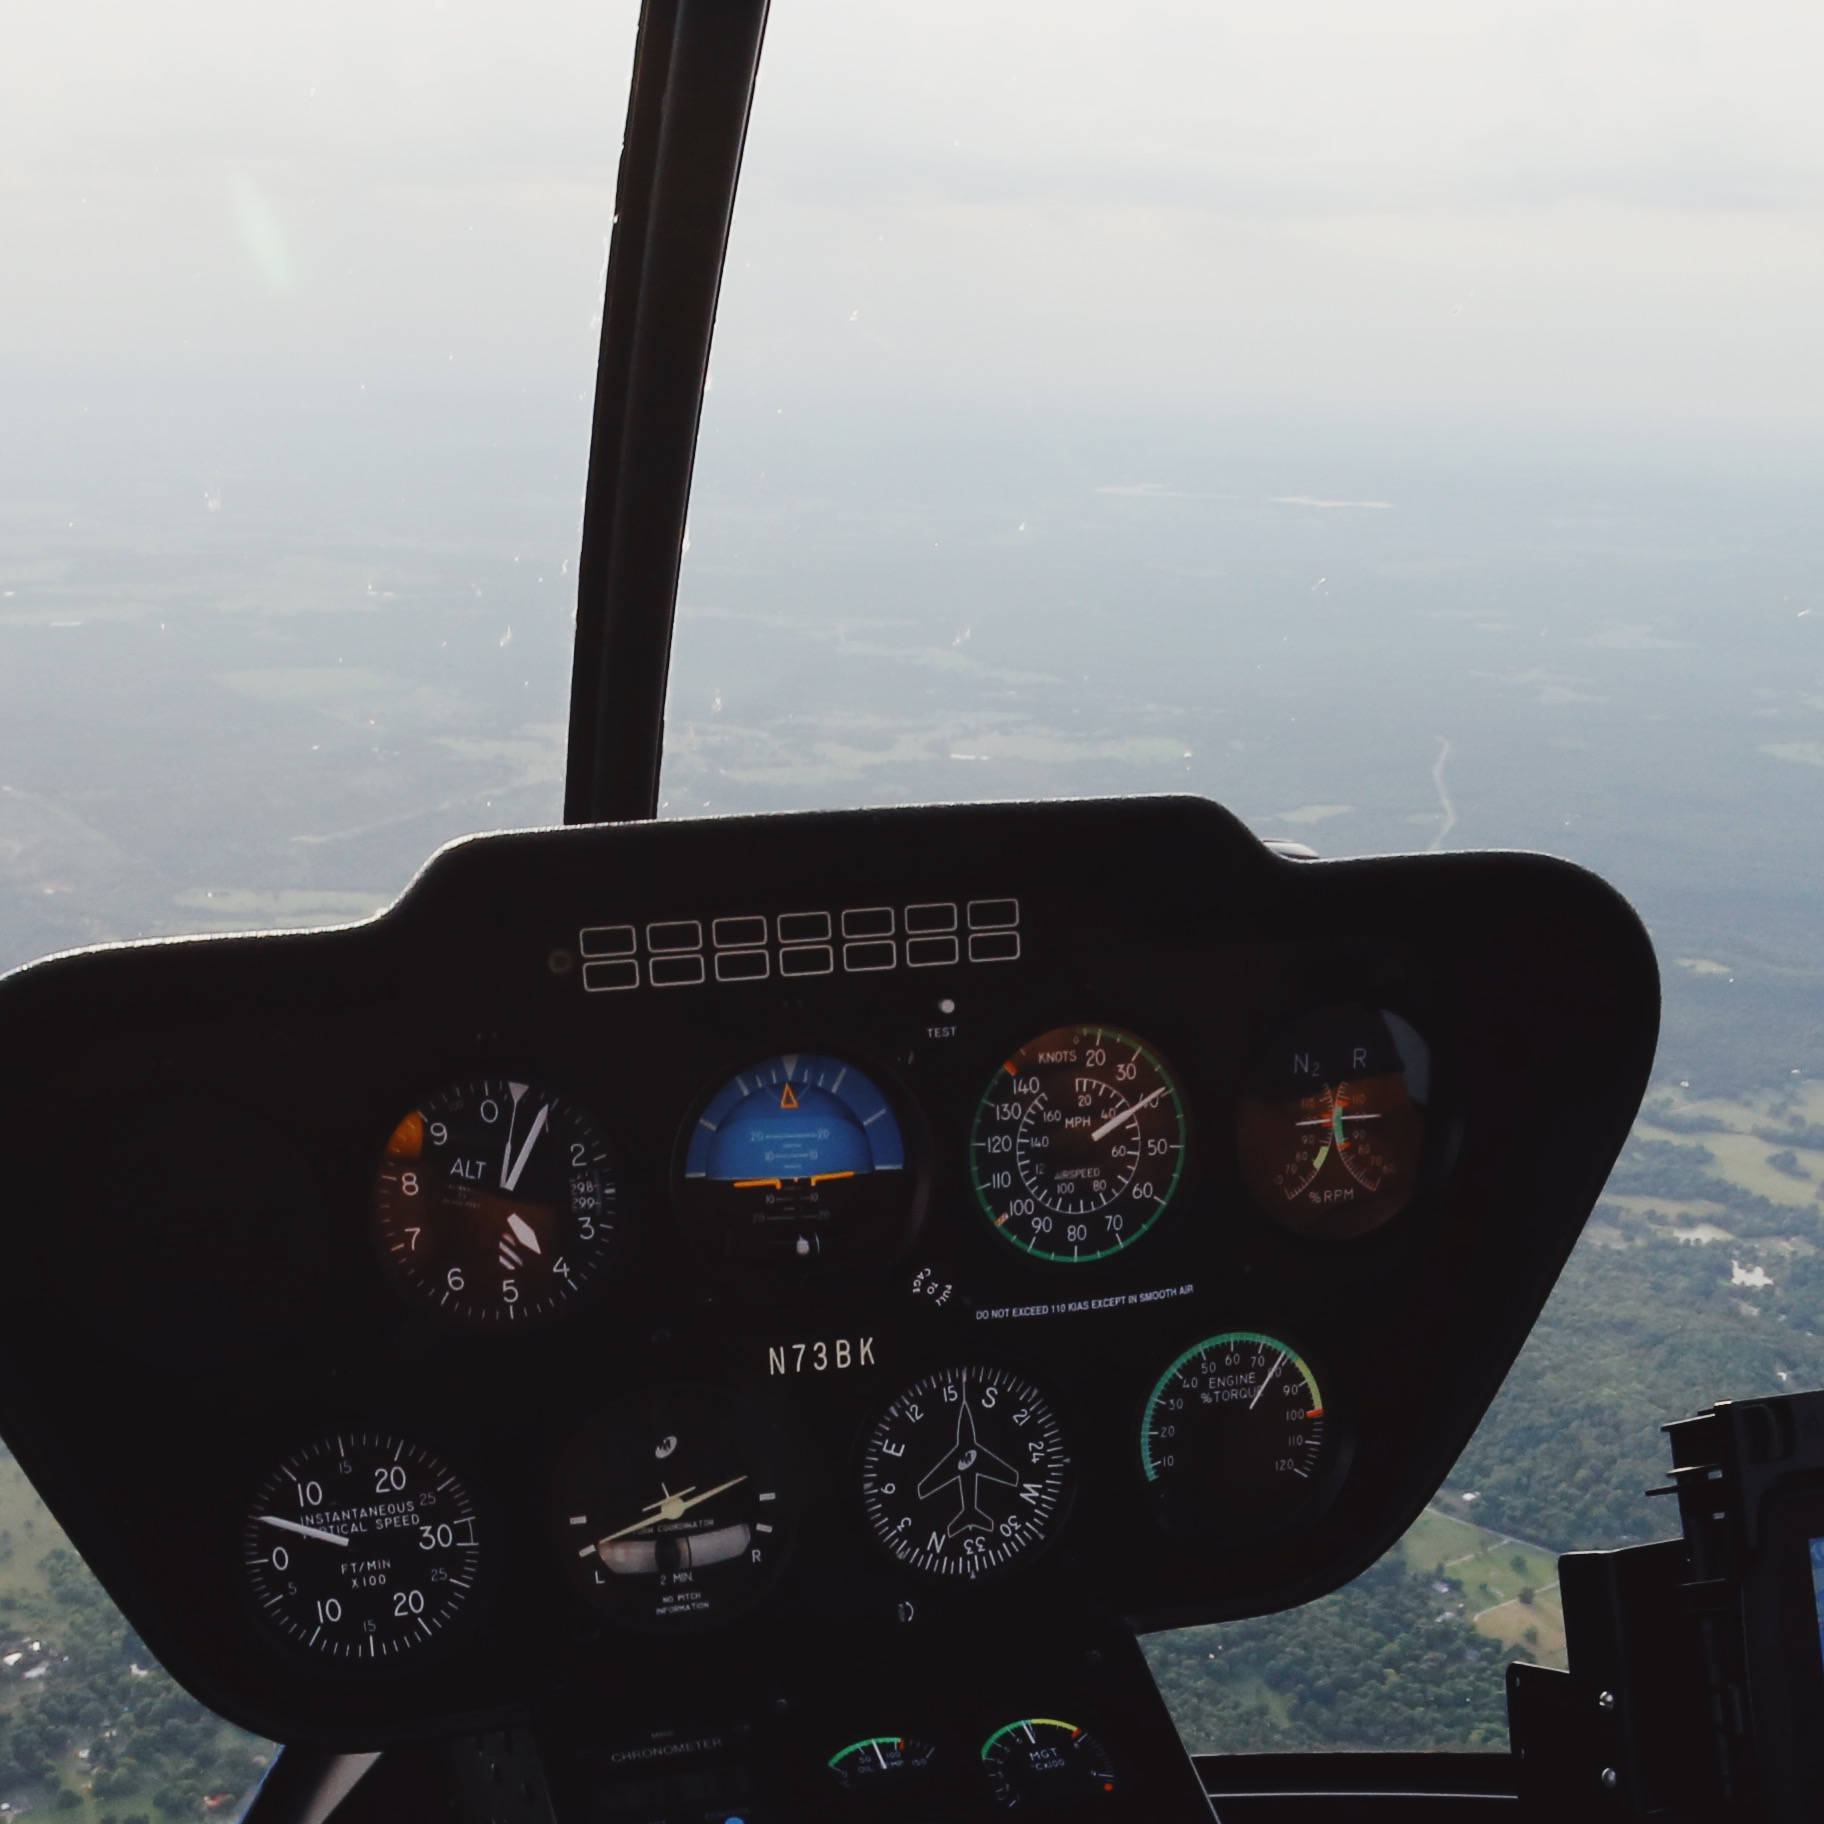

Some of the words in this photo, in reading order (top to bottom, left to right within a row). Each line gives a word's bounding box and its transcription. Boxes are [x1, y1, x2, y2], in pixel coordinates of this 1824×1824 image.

[927, 1026, 957, 1039] TEST
[1038, 1050, 1077, 1064] KNOTS
[1086, 1049, 1106, 1066] 20
[1353, 1048, 1367, 1068] R
[1116, 1064, 1136, 1081] 30
[1013, 1076, 1040, 1094] 140
[480, 1100, 498, 1122] 0
[996, 1104, 1022, 1121] 130
[1043, 1110, 1062, 1122] 160
[1065, 1116, 1091, 1128] MPH
[430, 1123, 447, 1145] 9
[987, 1135, 1012, 1153] 120
[1111, 1146, 1126, 1157] 60
[1148, 1139, 1168, 1155] 50
[571, 1144, 586, 1166] 2
[450, 1158, 487, 1180] ALT
[402, 1173, 419, 1196] 8
[992, 1171, 1011, 1188] 110
[1057, 1182, 1074, 1194] 100
[1093, 1180, 1106, 1192] 80
[1132, 1183, 1153, 1199] 60
[1009, 1199, 1034, 1216] 100
[578, 1217, 594, 1240] 3
[1031, 1217, 1052, 1233] 90
[1105, 1214, 1124, 1231] 70
[404, 1228, 420, 1250] 7
[1067, 1224, 1087, 1241] 80
[553, 1257, 570, 1278] 4
[447, 1268, 464, 1291] 6
[912, 1268, 931, 1294] CAGE
[502, 1280, 518, 1302] 5
[976, 1310, 989, 1320] DO
[991, 1308, 1009, 1319] NOT
[1012, 1305, 1049, 1317] EXCEED
[1051, 1304, 1066, 1314] 110
[1068, 1301, 1089, 1312] KIAS
[1091, 1296, 1126, 1309] EXCEPT
[1128, 1295, 1138, 1304] IN
[1139, 1288, 1177, 1302] SMOOTH
[1179, 1284, 1194, 1295] AIR
[768, 1337, 876, 1375] N73BK
[1225, 1353, 1240, 1366] 60
[1250, 1356, 1265, 1367] 70
[1201, 1362, 1216, 1374] 50
[1182, 1377, 1198, 1388] 40
[1208, 1372, 1256, 1389] ENGINE
[943, 1385, 958, 1402] 15
[982, 1387, 998, 1408] S
[1283, 1385, 1298, 1396] 90
[905, 1404, 924, 1423] 12
[1012, 1408, 1031, 1426] 21
[1285, 1410, 1304, 1421] 100
[1160, 1426, 1175, 1438] 20
[1288, 1435, 1303, 1446] 110
[882, 1439, 905, 1457] E
[1028, 1441, 1044, 1464] 24
[339, 1460, 352, 1474] 15
[1163, 1456, 1174, 1467] 10
[1276, 1460, 1294, 1472] 120
[375, 1466, 406, 1493] 20
[297, 1481, 322, 1507] 10
[300, 1501, 415, 1526] INSTANTANEOUS
[376, 1513, 420, 1530] SPEED
[1000, 1515, 1022, 1537] 30
[419, 1524, 453, 1550] 30
[927, 1531, 946, 1553] N
[964, 1536, 986, 1555] 33
[272, 1547, 288, 1570] 0
[752, 1549, 762, 1563] R
[341, 1559, 391, 1575] FT/MIN
[431, 1568, 447, 1581] 25
[351, 1574, 386, 1589] X100
[595, 1571, 605, 1584] L
[317, 1598, 342, 1624] 10
[393, 1589, 424, 1616] 20
[656, 1601, 710, 1615] INFORMATION
[363, 1620, 376, 1632] 15
[611, 1738, 723, 1763] CHRONOMETER
[1029, 1747, 1058, 1762] MGT
